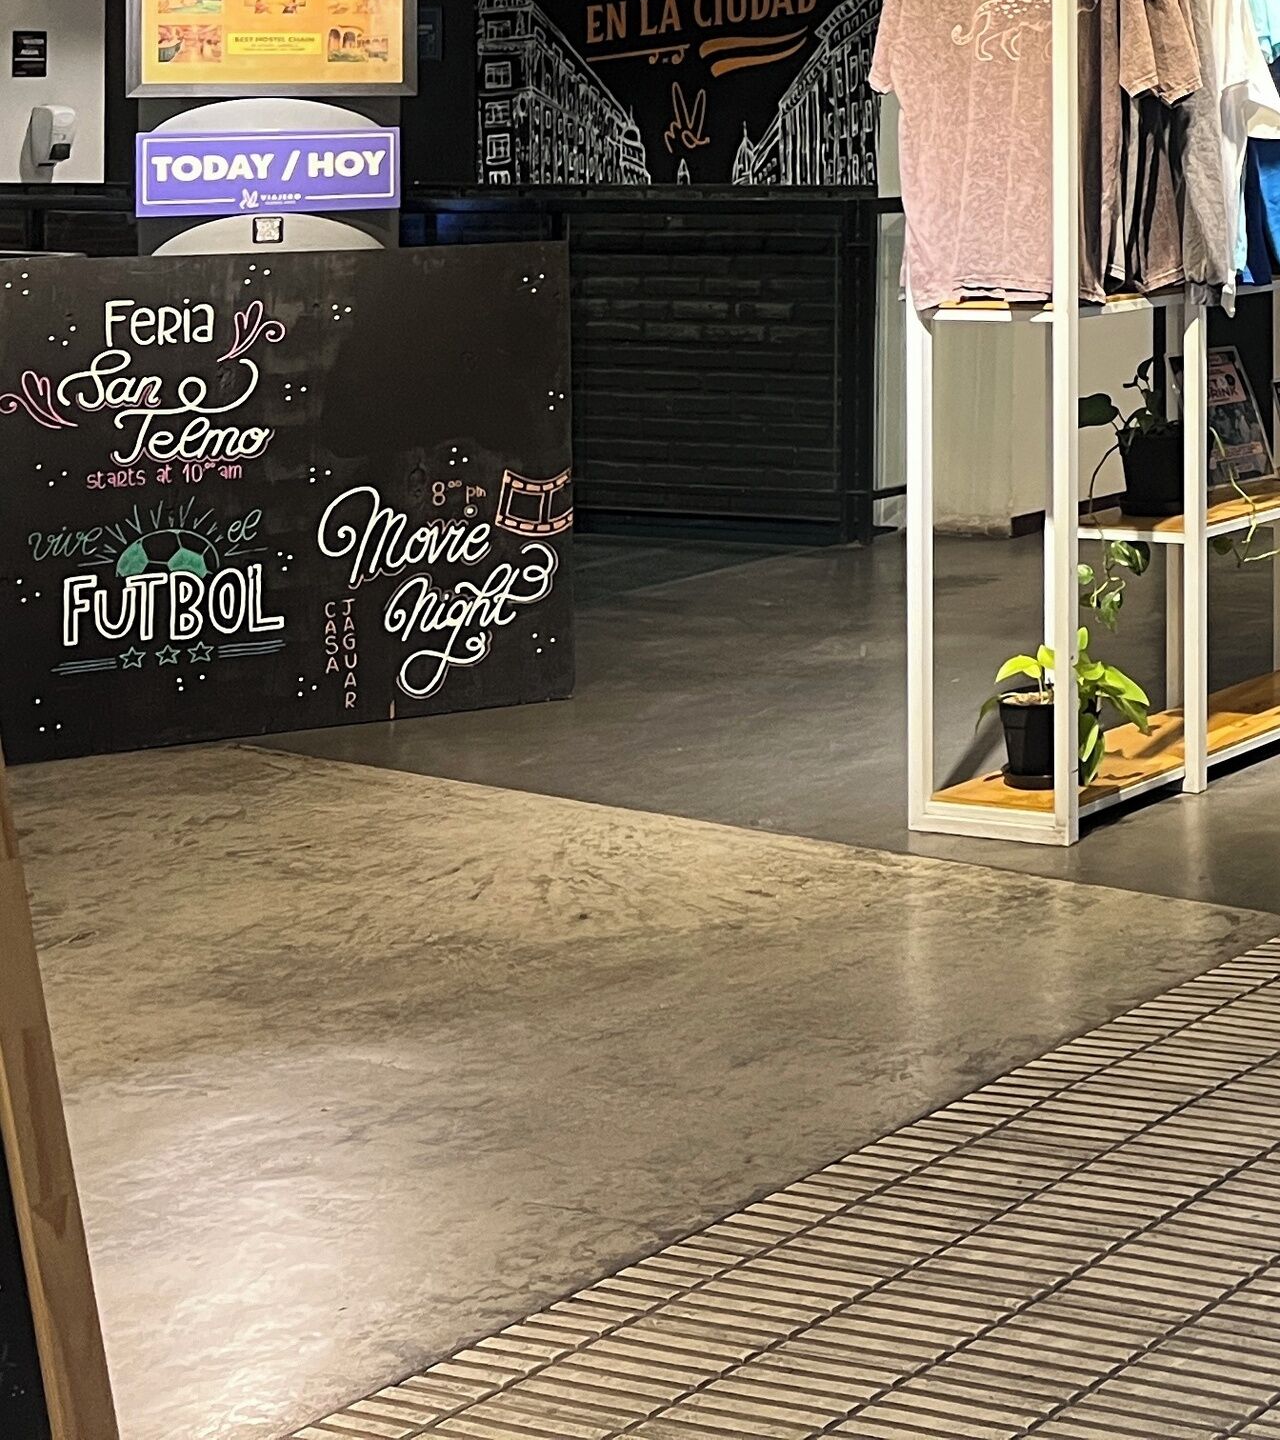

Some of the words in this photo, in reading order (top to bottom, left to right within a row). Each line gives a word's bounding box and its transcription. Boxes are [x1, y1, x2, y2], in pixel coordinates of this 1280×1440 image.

[586, 3, 627, 46] EN
[151, 153, 274, 182] TODAY
[281, 150, 301, 182] /
[307, 150, 387, 178] HOY
[57, 350, 163, 409] San
[112, 406, 273, 463] Telmo
[156, 463, 173, 484] at
[217, 464, 243, 480] am
[28, 525, 104, 561] vive
[227, 508, 263, 542] el
[318, 486, 491, 590] Movie
[63, 563, 285, 646] FUTBOL
[384, 543, 559, 698] Night
[324, 601, 340, 674] CASA
[342, 598, 359, 709] JAGUAR
